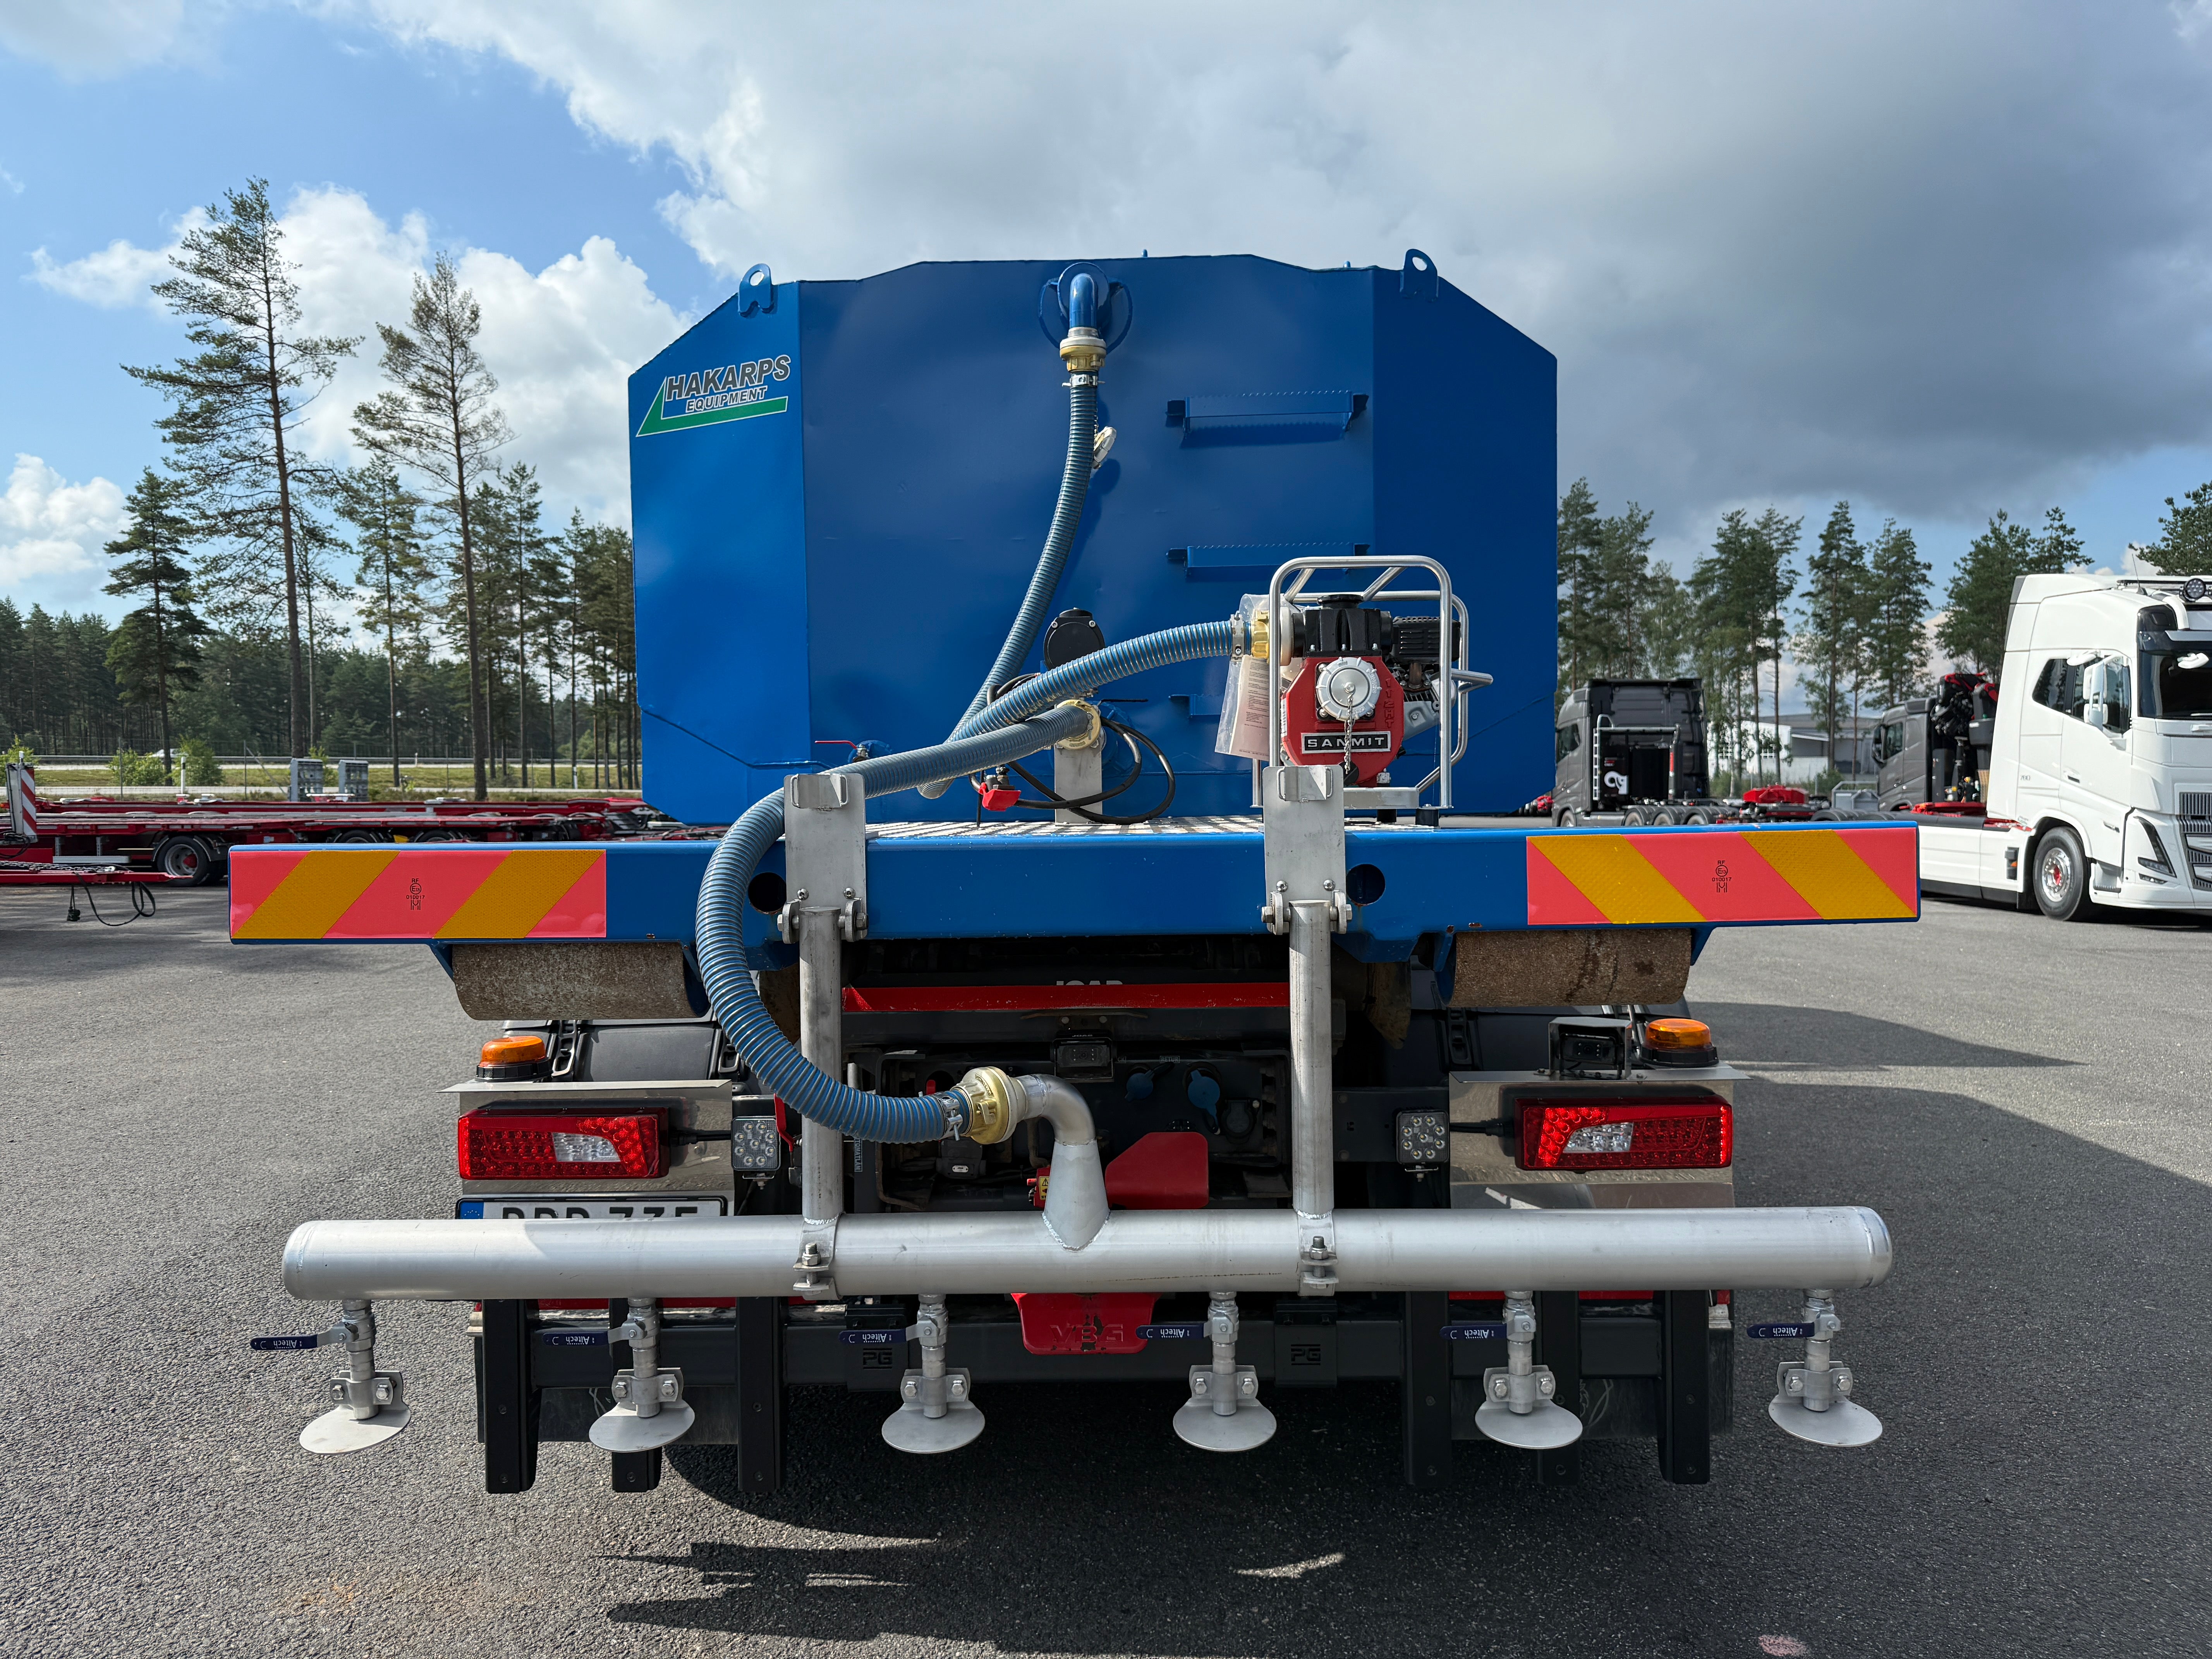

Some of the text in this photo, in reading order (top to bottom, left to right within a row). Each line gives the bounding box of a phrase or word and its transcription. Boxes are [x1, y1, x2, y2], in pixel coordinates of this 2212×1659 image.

[665, 354, 791, 402] HAKARPS
[685, 385, 768, 413] EQUIPMENT
[1308, 737, 1384, 747] SANMIT
[1050, 1324, 1123, 1343] VBG
[1161, 1329, 1185, 1338] Altech
[1465, 1329, 1489, 1339] Altech
[1773, 1328, 1798, 1336] Altech
[566, 1336, 589, 1345] Altech
[862, 1334, 887, 1342] Altech
[273, 1340, 297, 1348] Altech
[863, 1352, 892, 1365] PG
[1291, 1348, 1321, 1362] PG
